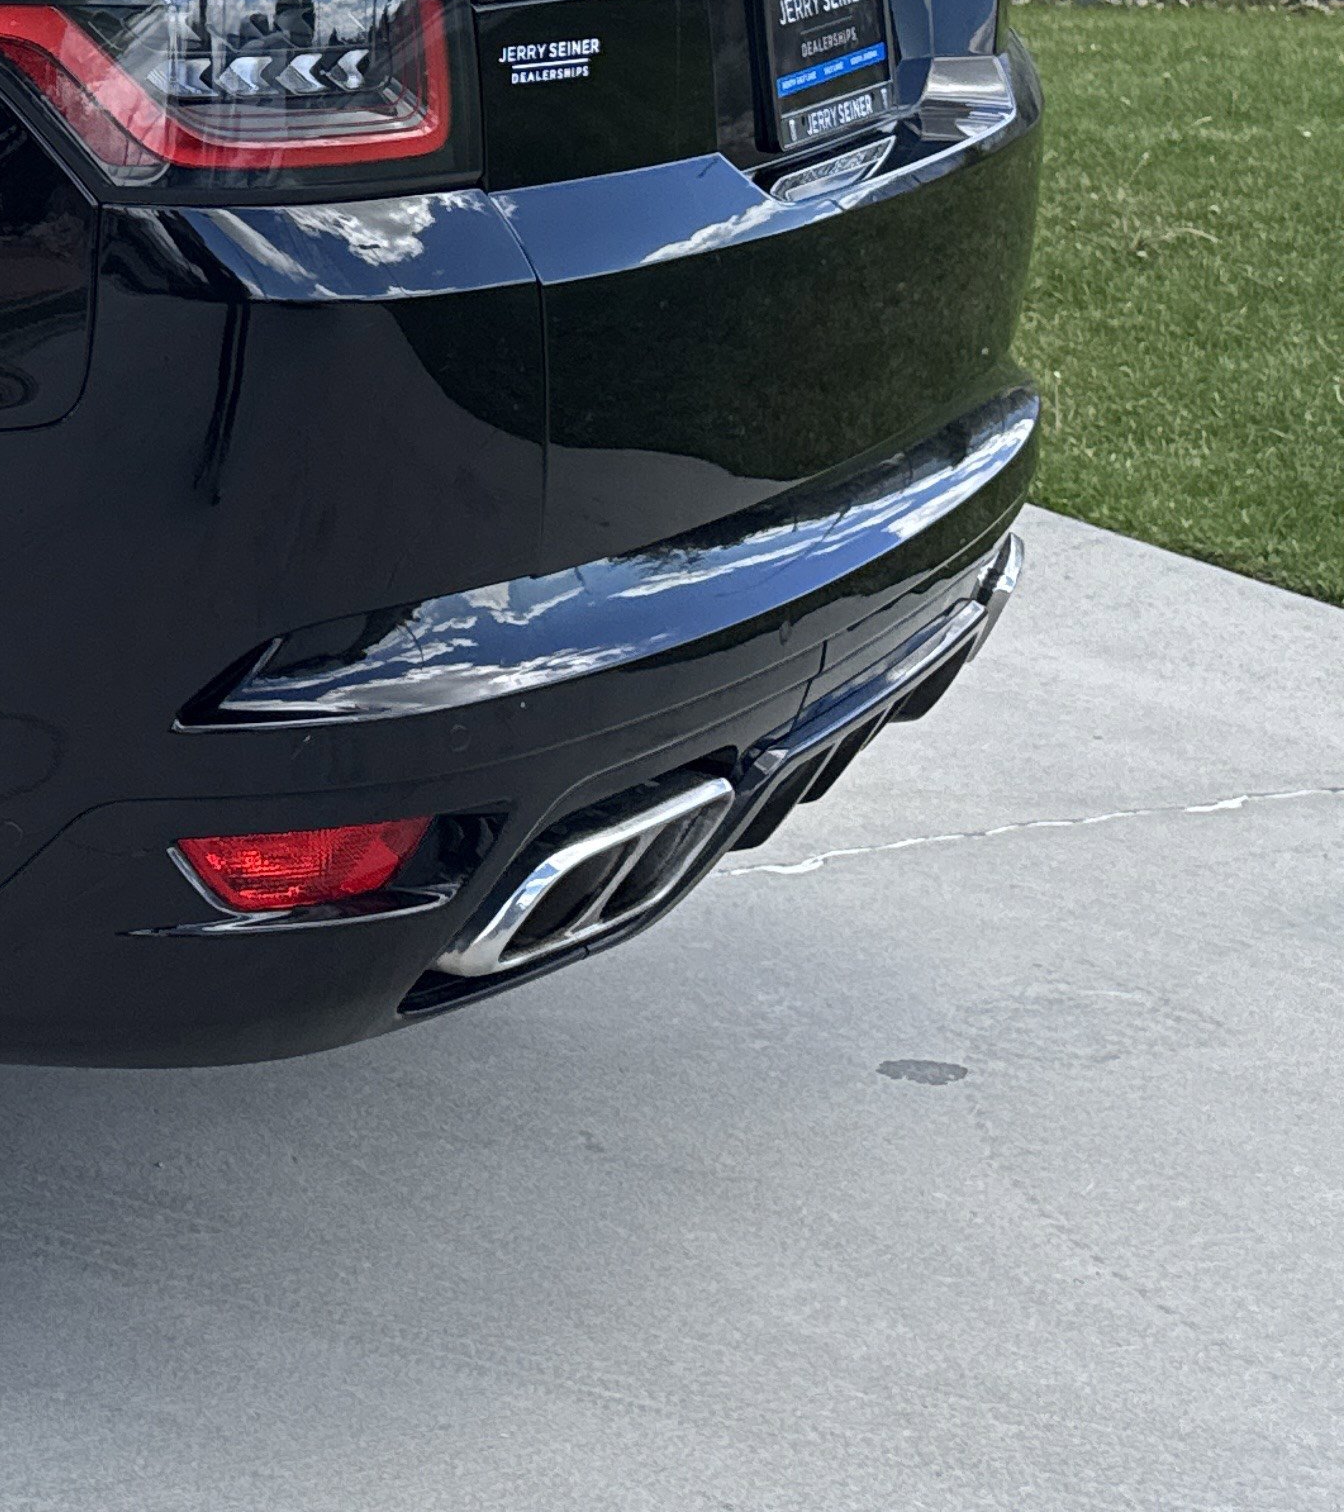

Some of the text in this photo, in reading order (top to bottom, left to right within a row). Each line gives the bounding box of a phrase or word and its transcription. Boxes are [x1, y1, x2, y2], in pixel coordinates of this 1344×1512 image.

[498, 38, 600, 63] JERRY SEINER
[801, 26, 857, 58] DEALERSHIPS
[512, 66, 589, 84] DEALERSHIPS
[806, 94, 873, 136] JERRY SEINER
